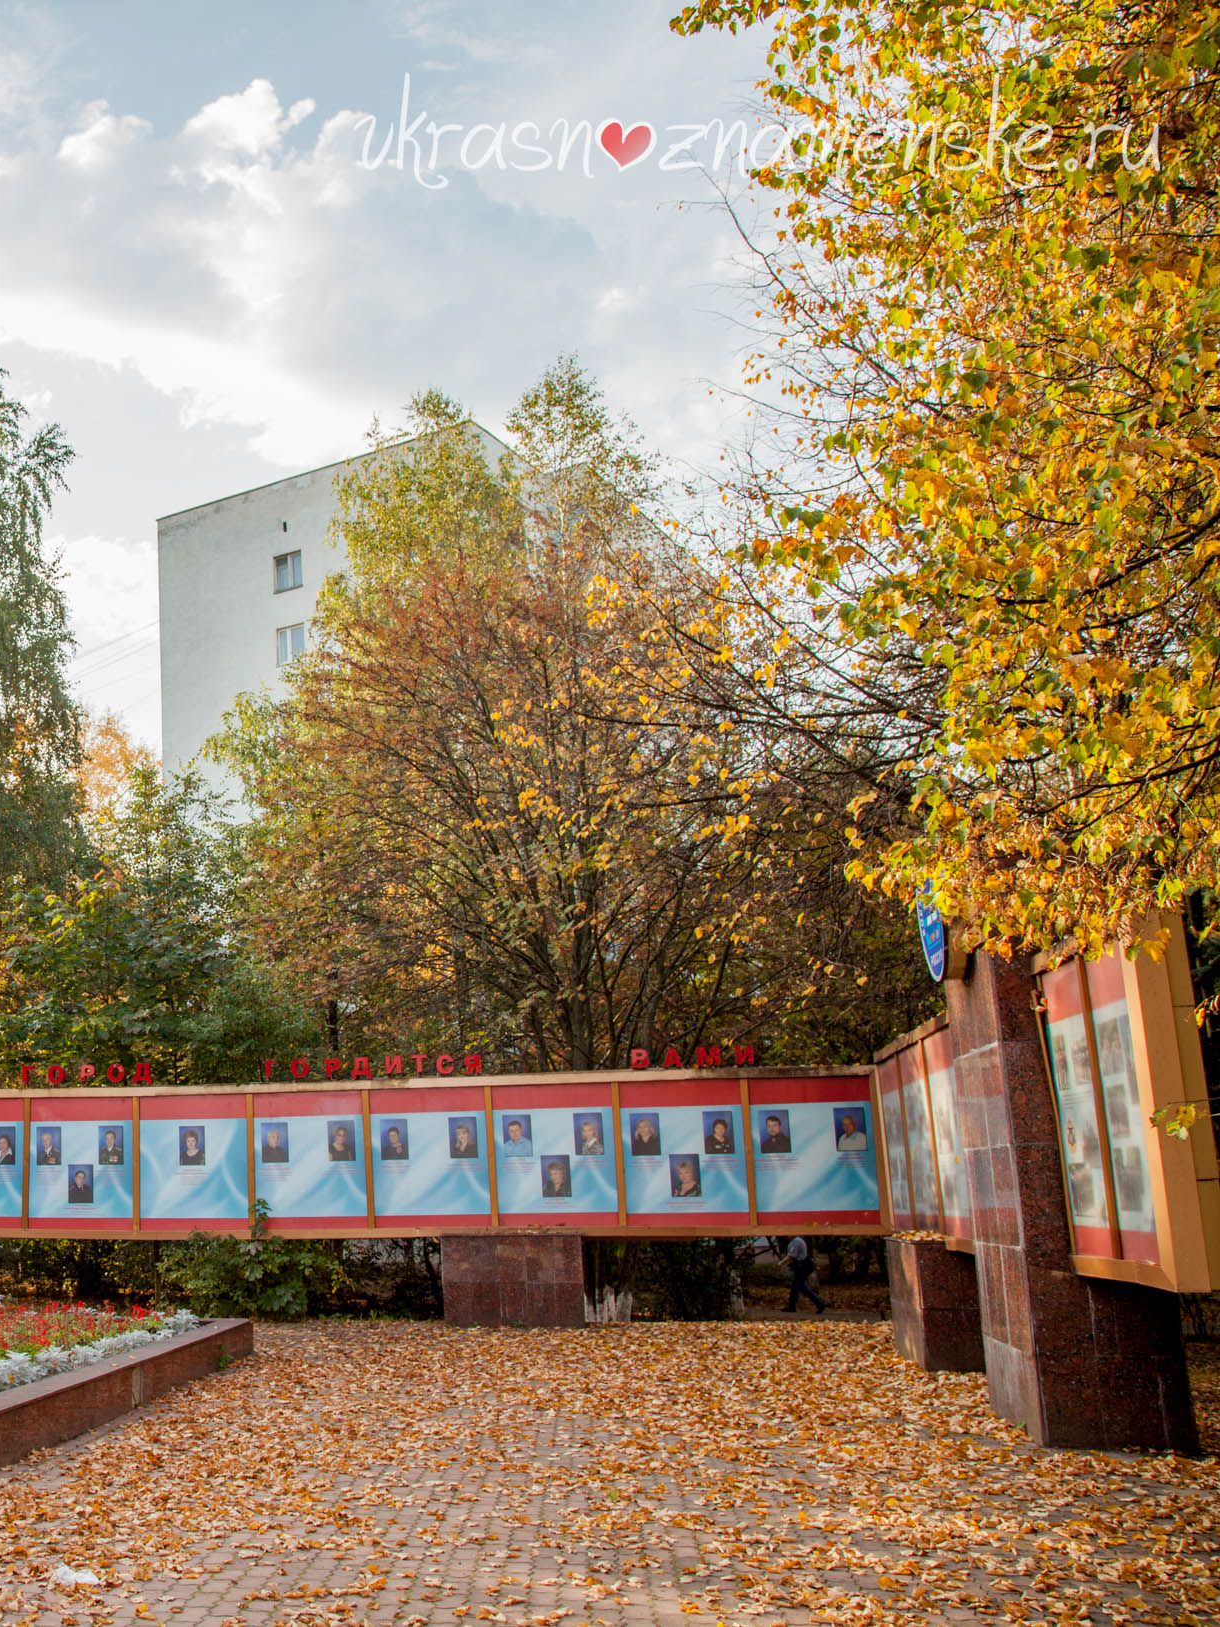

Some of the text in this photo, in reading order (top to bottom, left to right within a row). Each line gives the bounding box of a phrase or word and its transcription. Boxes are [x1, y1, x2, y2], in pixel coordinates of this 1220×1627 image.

[21, 1044, 755, 1085] ГОРОД ГОРДИТСЯ ВАМИ
